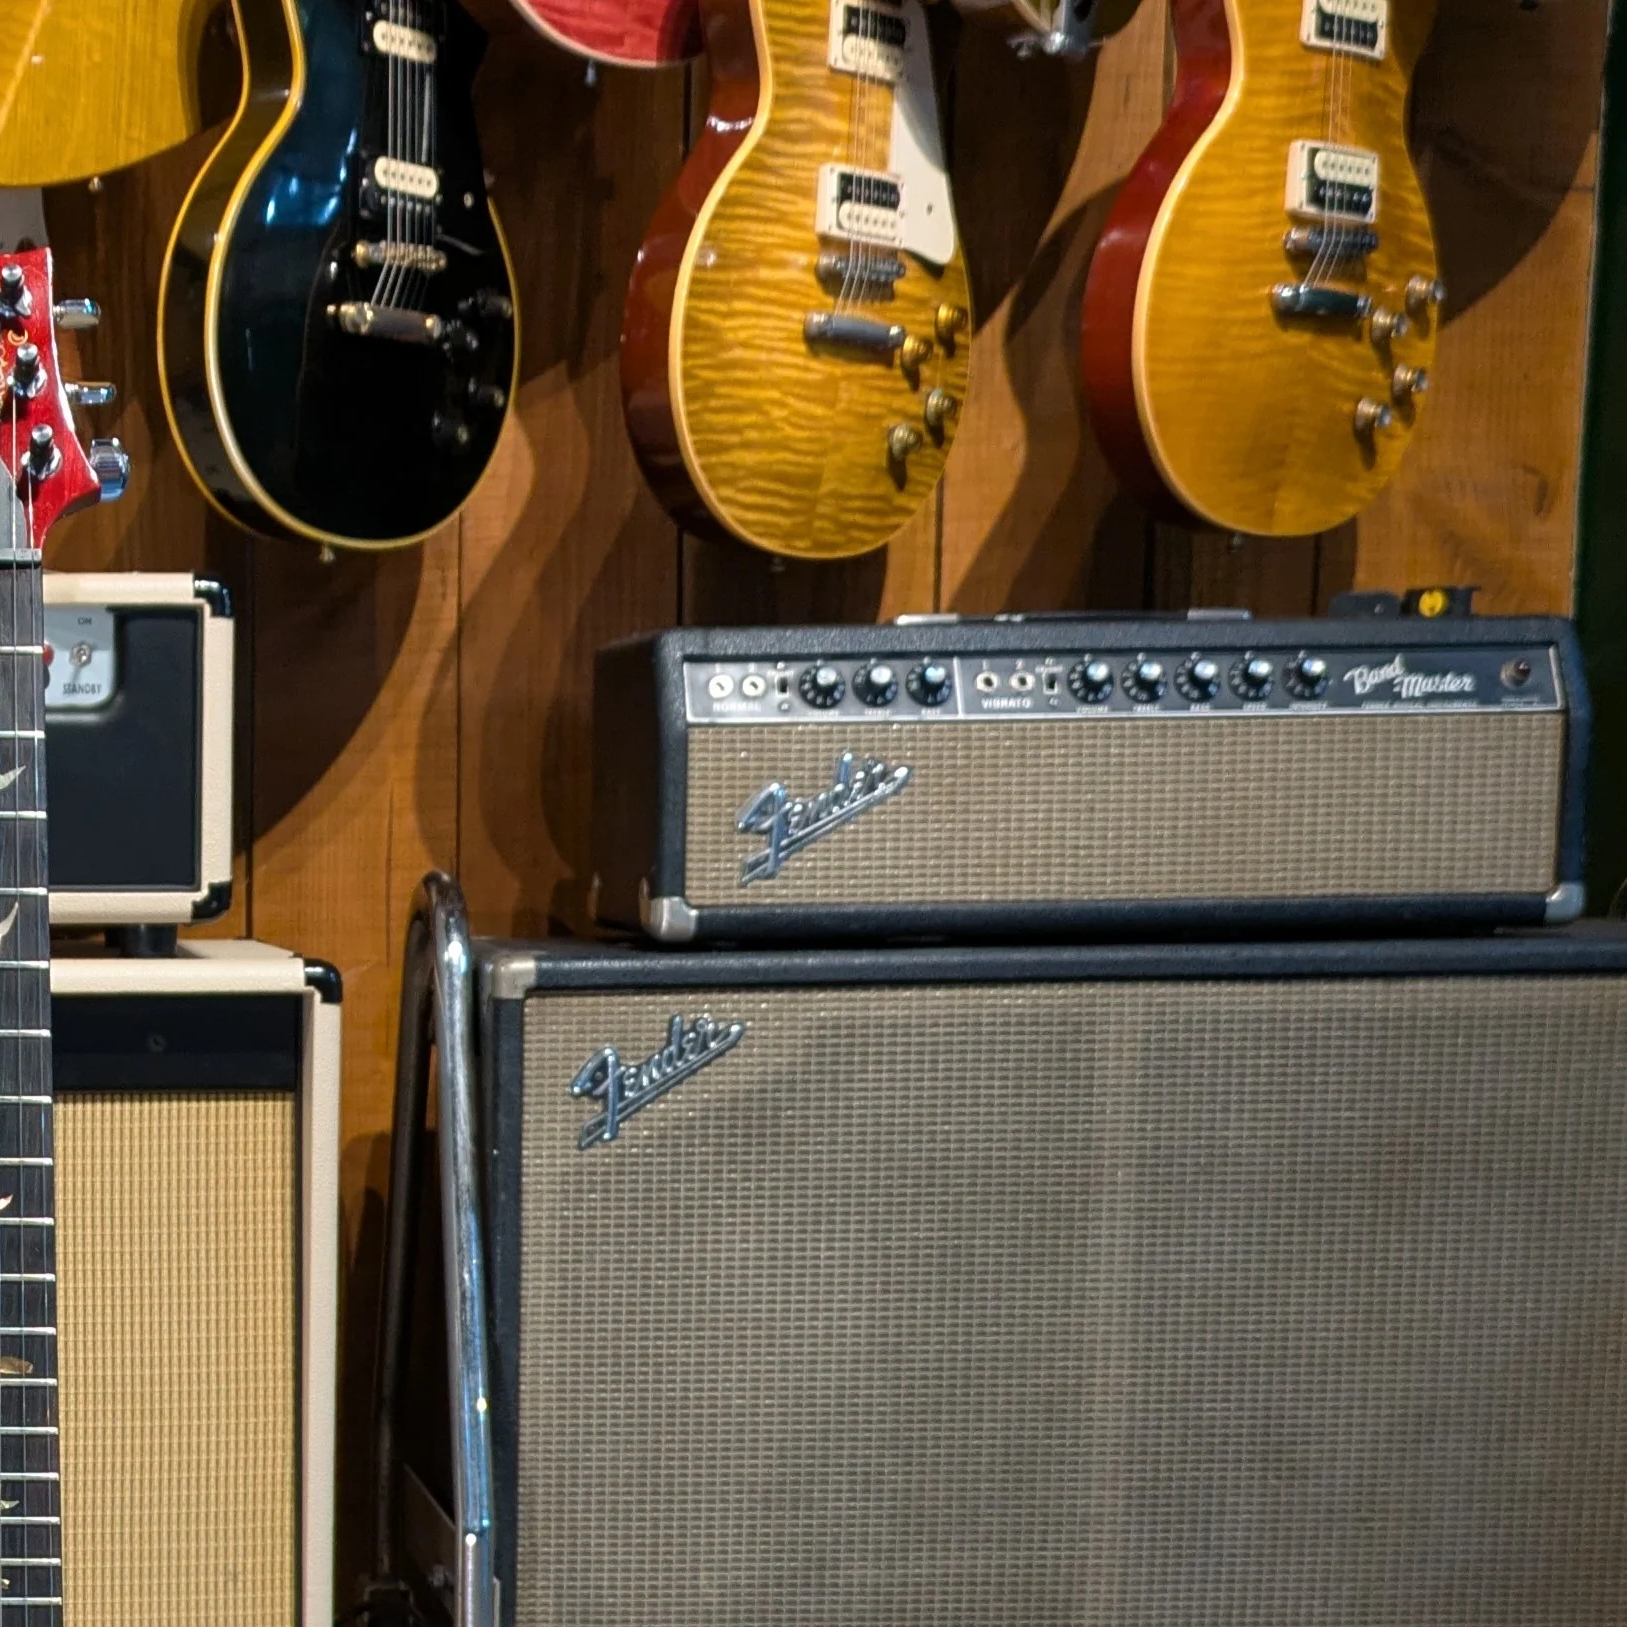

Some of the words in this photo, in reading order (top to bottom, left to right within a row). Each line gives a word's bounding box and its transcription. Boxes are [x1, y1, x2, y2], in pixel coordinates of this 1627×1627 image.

[77, 616, 92, 626] ON
[1344, 652, 1406, 695] Band
[1393, 671, 1477, 698] Master
[62, 683, 102, 695] STANDBY
[712, 701, 761, 712] NORMAL
[981, 697, 1031, 709] VIBRATO
[737, 751, 911, 887] Fender
[570, 1012, 744, 1150] Fender
